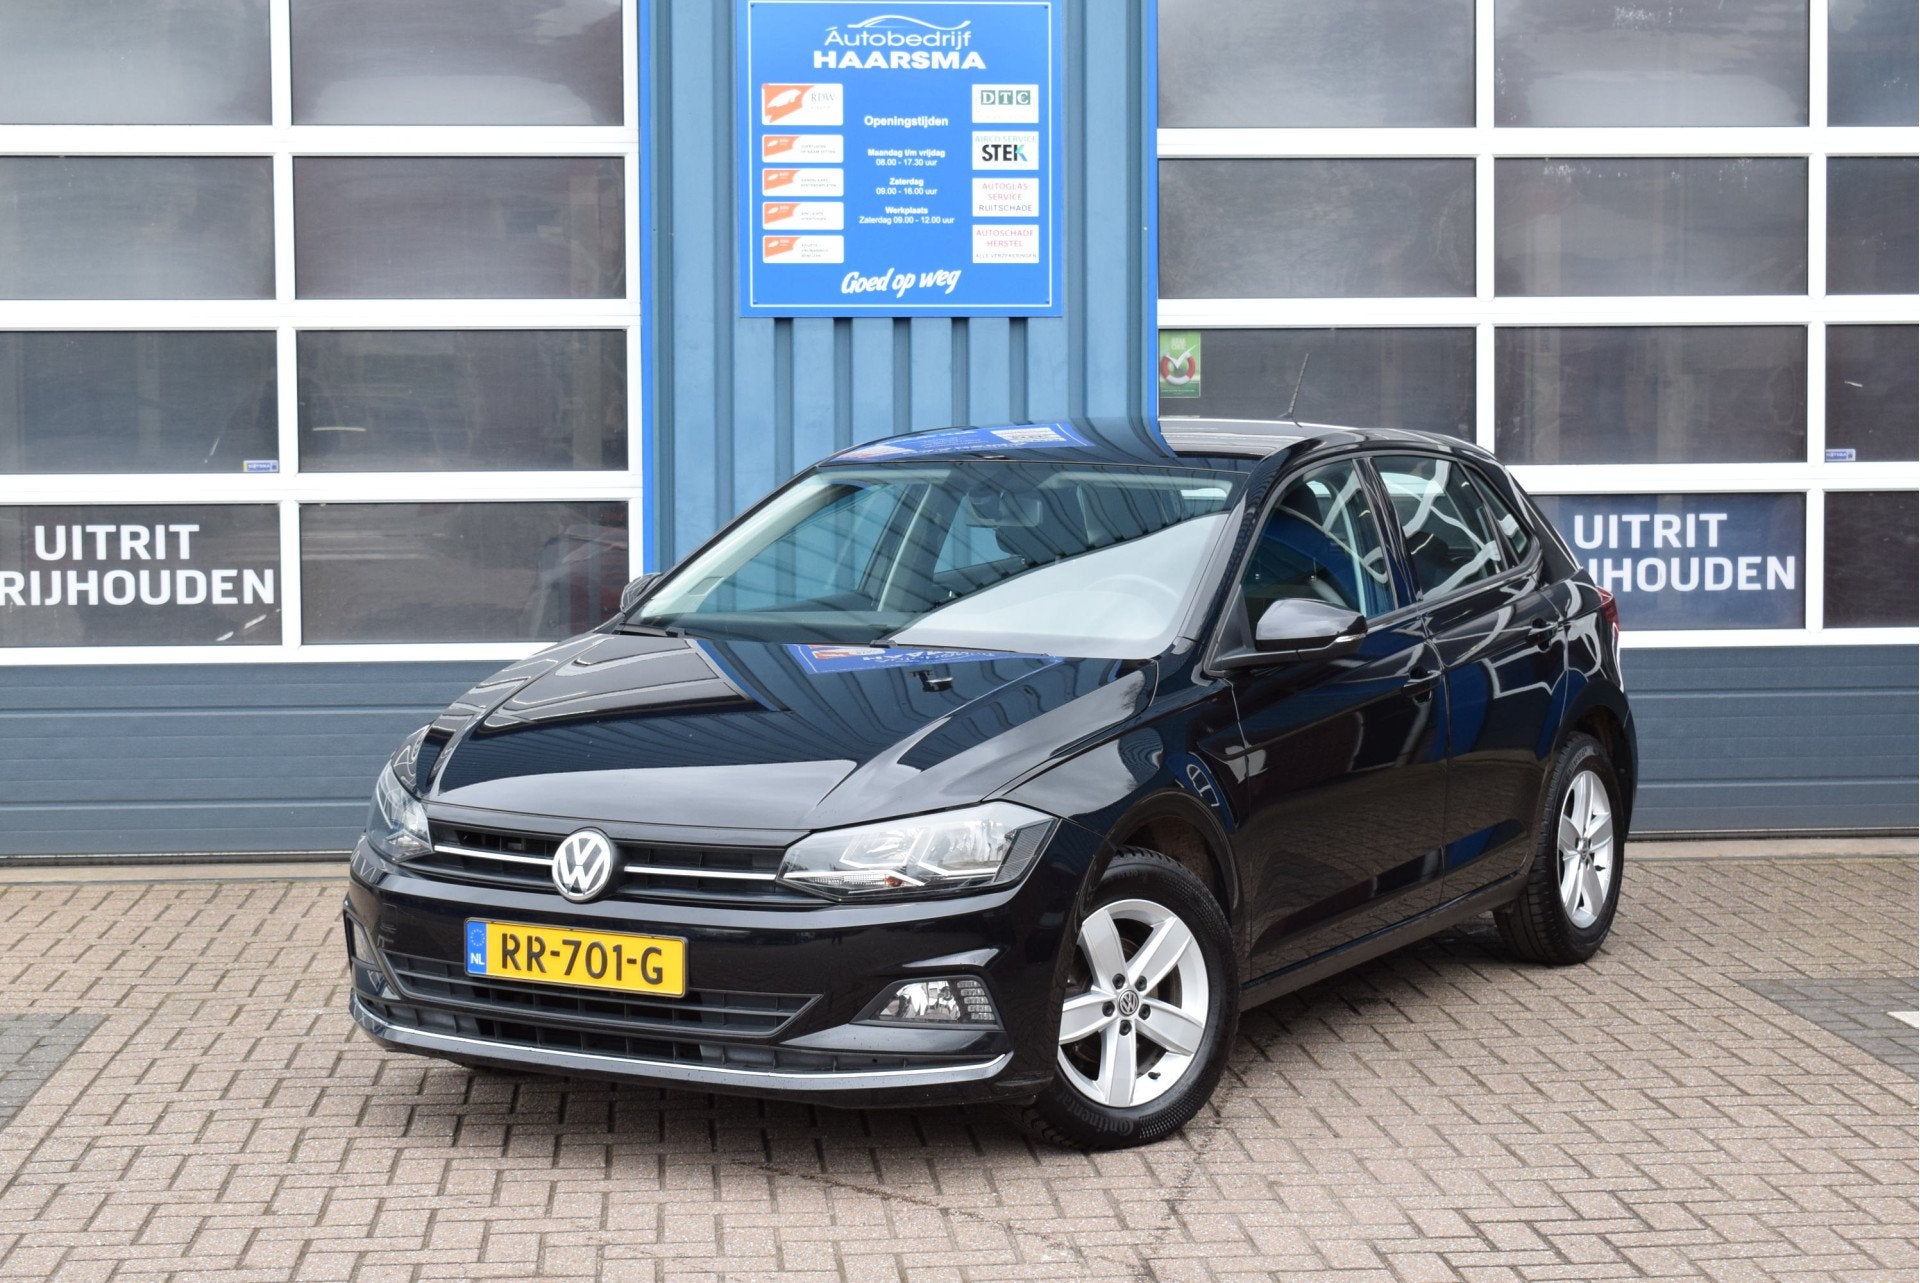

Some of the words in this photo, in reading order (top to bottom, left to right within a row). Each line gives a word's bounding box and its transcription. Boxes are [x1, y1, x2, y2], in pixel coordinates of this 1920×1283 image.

[824, 30, 972, 50] Autobedrijf
[813, 50, 987, 69] HAARSMA
[981, 90, 1030, 105] DTC
[864, 115, 949, 128] Openingstijden
[867, 148, 903, 158] Maandag
[919, 148, 946, 158] vrijdag
[981, 144, 1028, 162] STEK
[903, 158, 924, 167] 17.30
[889, 177, 925, 187] Zaterdag
[982, 182, 1029, 190] AUTOGLAS
[987, 193, 1023, 201] SERVICE
[885, 206, 929, 216] Werkplaats
[978, 204, 1033, 212] RUITSCHADE
[859, 216, 892, 226] Zaterdag
[921, 216, 941, 224] 12.00
[976, 229, 1034, 237] AUTOSCHADE
[841, 267, 895, 294] Goed
[891, 272, 917, 299] op
[919, 269, 962, 295] weg
[1573, 512, 1728, 550] UITRIT
[34, 524, 200, 561] UITRIT
[470, 952, 486, 966] NL
[501, 932, 664, 985] RR-701-G
